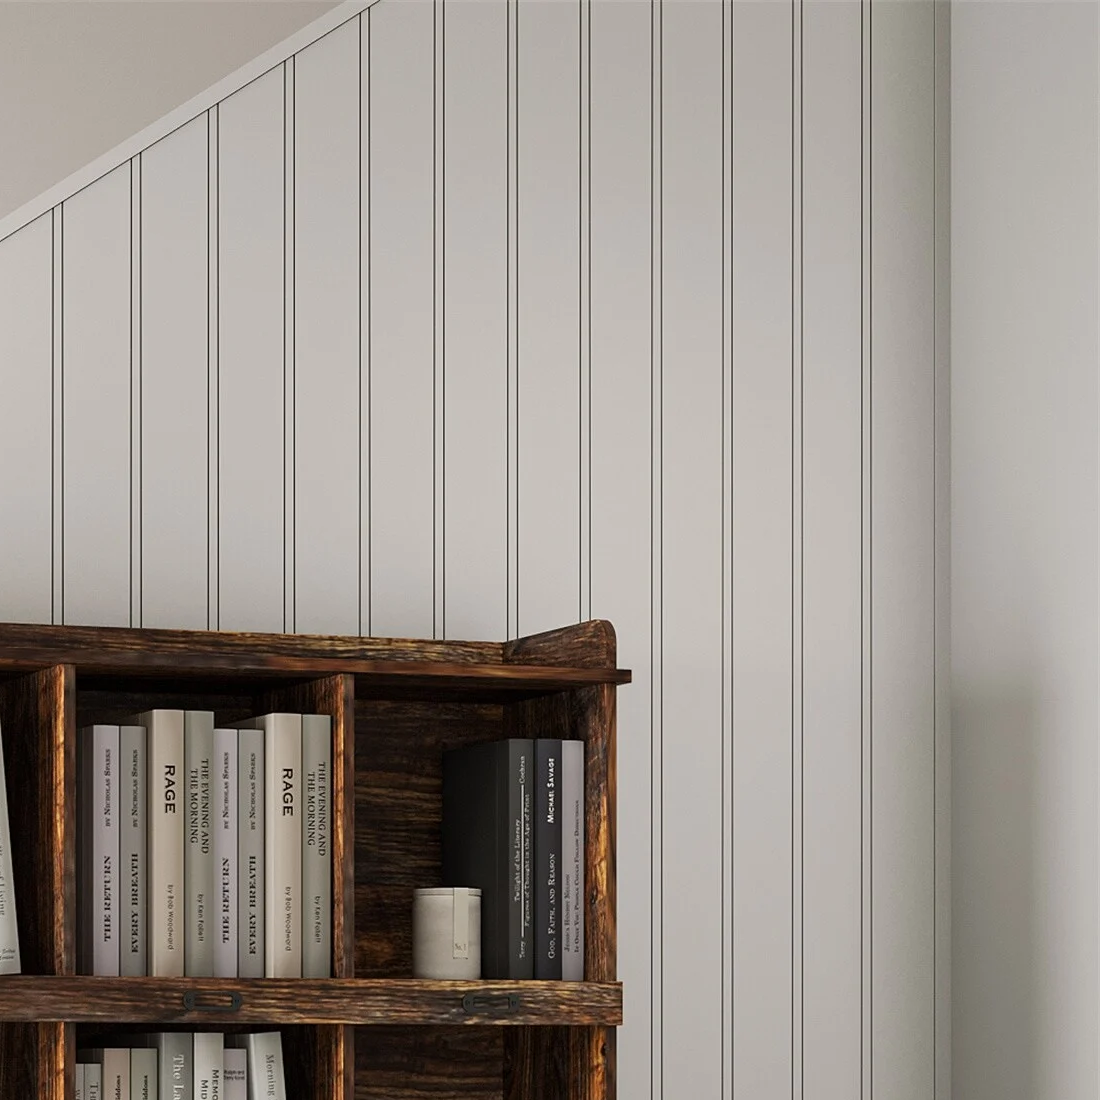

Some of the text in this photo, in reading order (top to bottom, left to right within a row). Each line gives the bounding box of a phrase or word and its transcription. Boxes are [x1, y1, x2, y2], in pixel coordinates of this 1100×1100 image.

[165, 765, 176, 814] RAGE
[190, 769, 198, 844] THE MORNING
[201, 759, 209, 854] THE EVENING AND
[282, 768, 293, 816] RAGE
[173, 1054, 184, 1079] The
